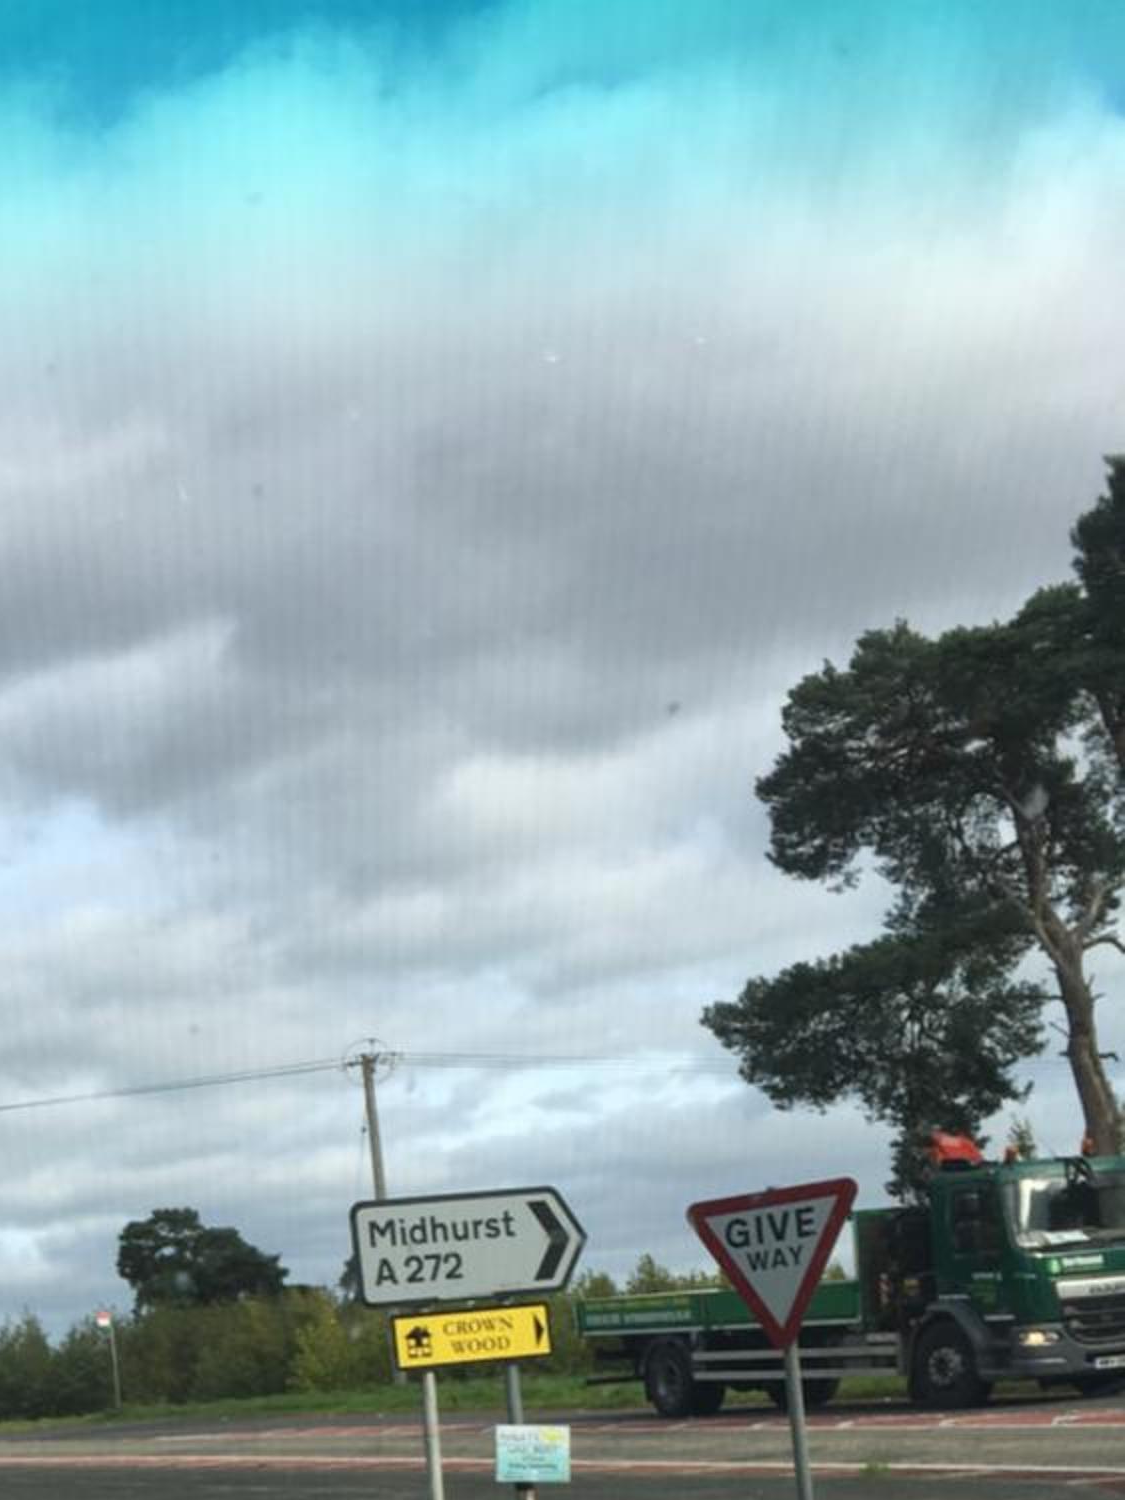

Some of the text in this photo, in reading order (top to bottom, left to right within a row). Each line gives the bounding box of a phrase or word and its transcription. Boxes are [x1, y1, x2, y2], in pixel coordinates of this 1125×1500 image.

[368, 1210, 515, 1249] Midhurst
[726, 1207, 816, 1248] GIVE
[747, 1247, 803, 1271] WAY
[443, 1316, 513, 1336] CROWN
[450, 1336, 511, 1354] WOOD
